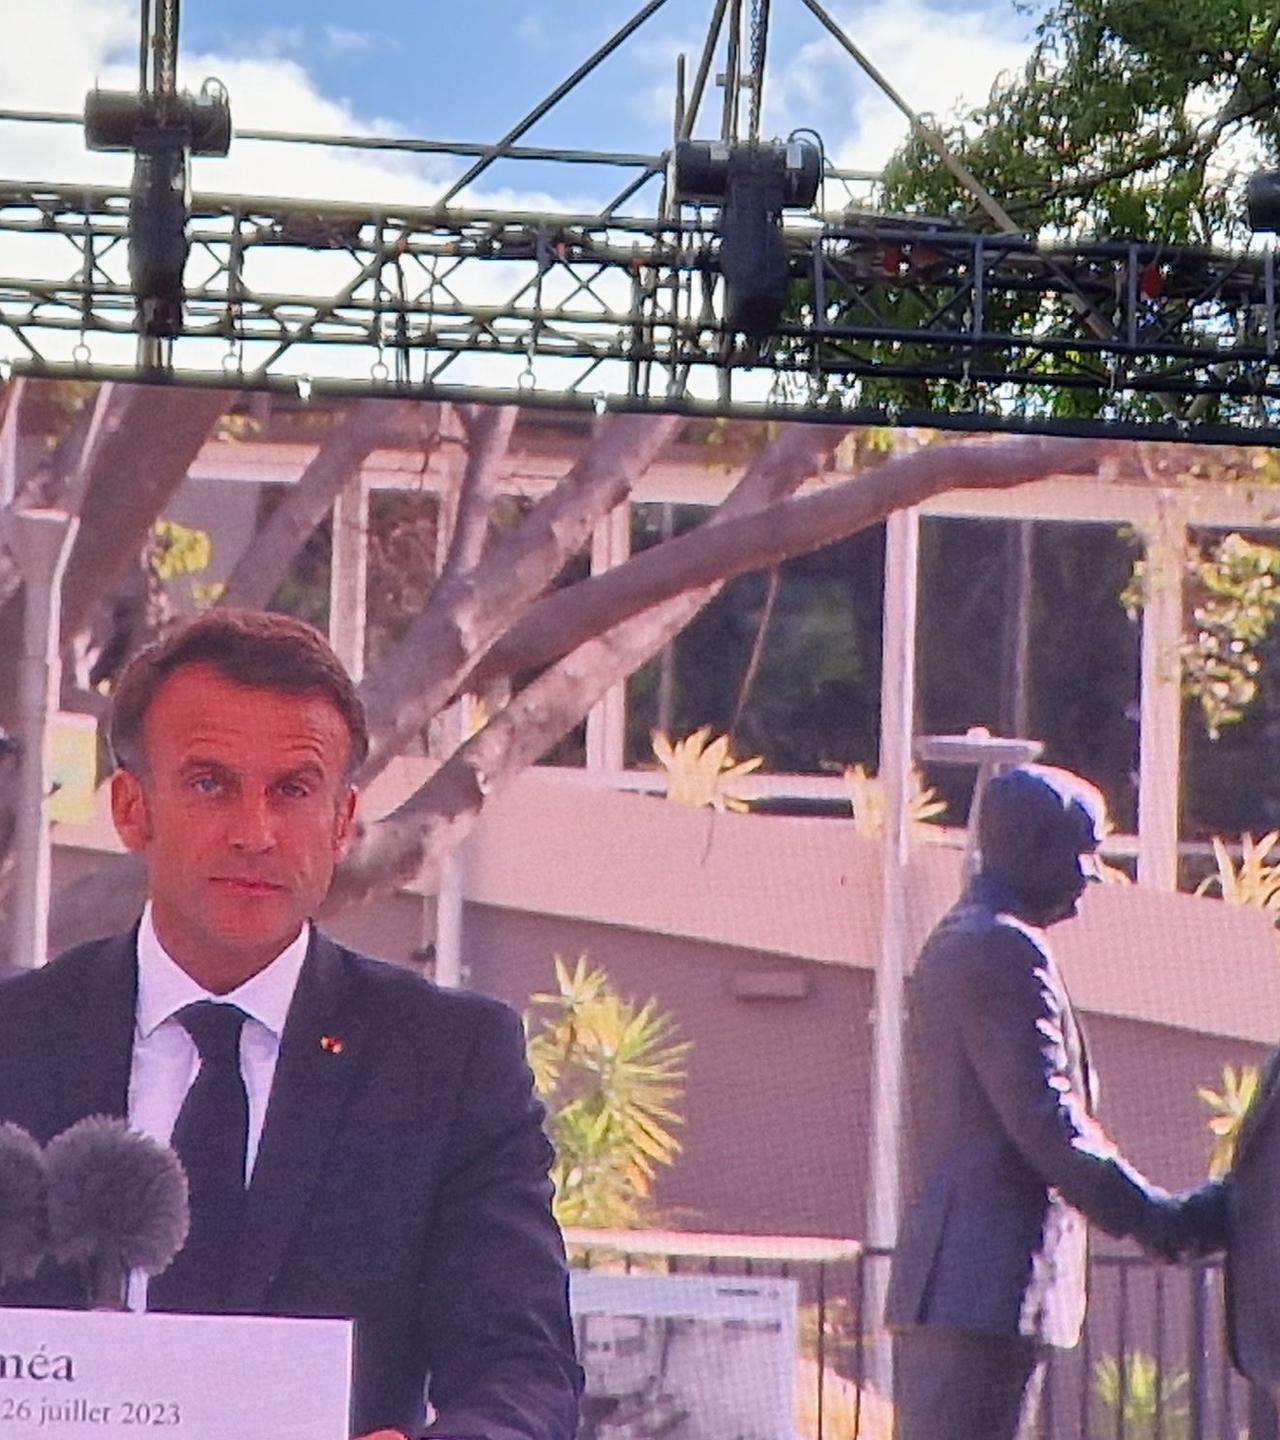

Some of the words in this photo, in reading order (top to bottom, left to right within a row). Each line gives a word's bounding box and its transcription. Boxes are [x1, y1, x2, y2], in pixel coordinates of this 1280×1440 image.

[1, 1397, 31, 1421] 26
[38, 1395, 111, 1427] juillet
[122, 1401, 180, 1425] 2023
